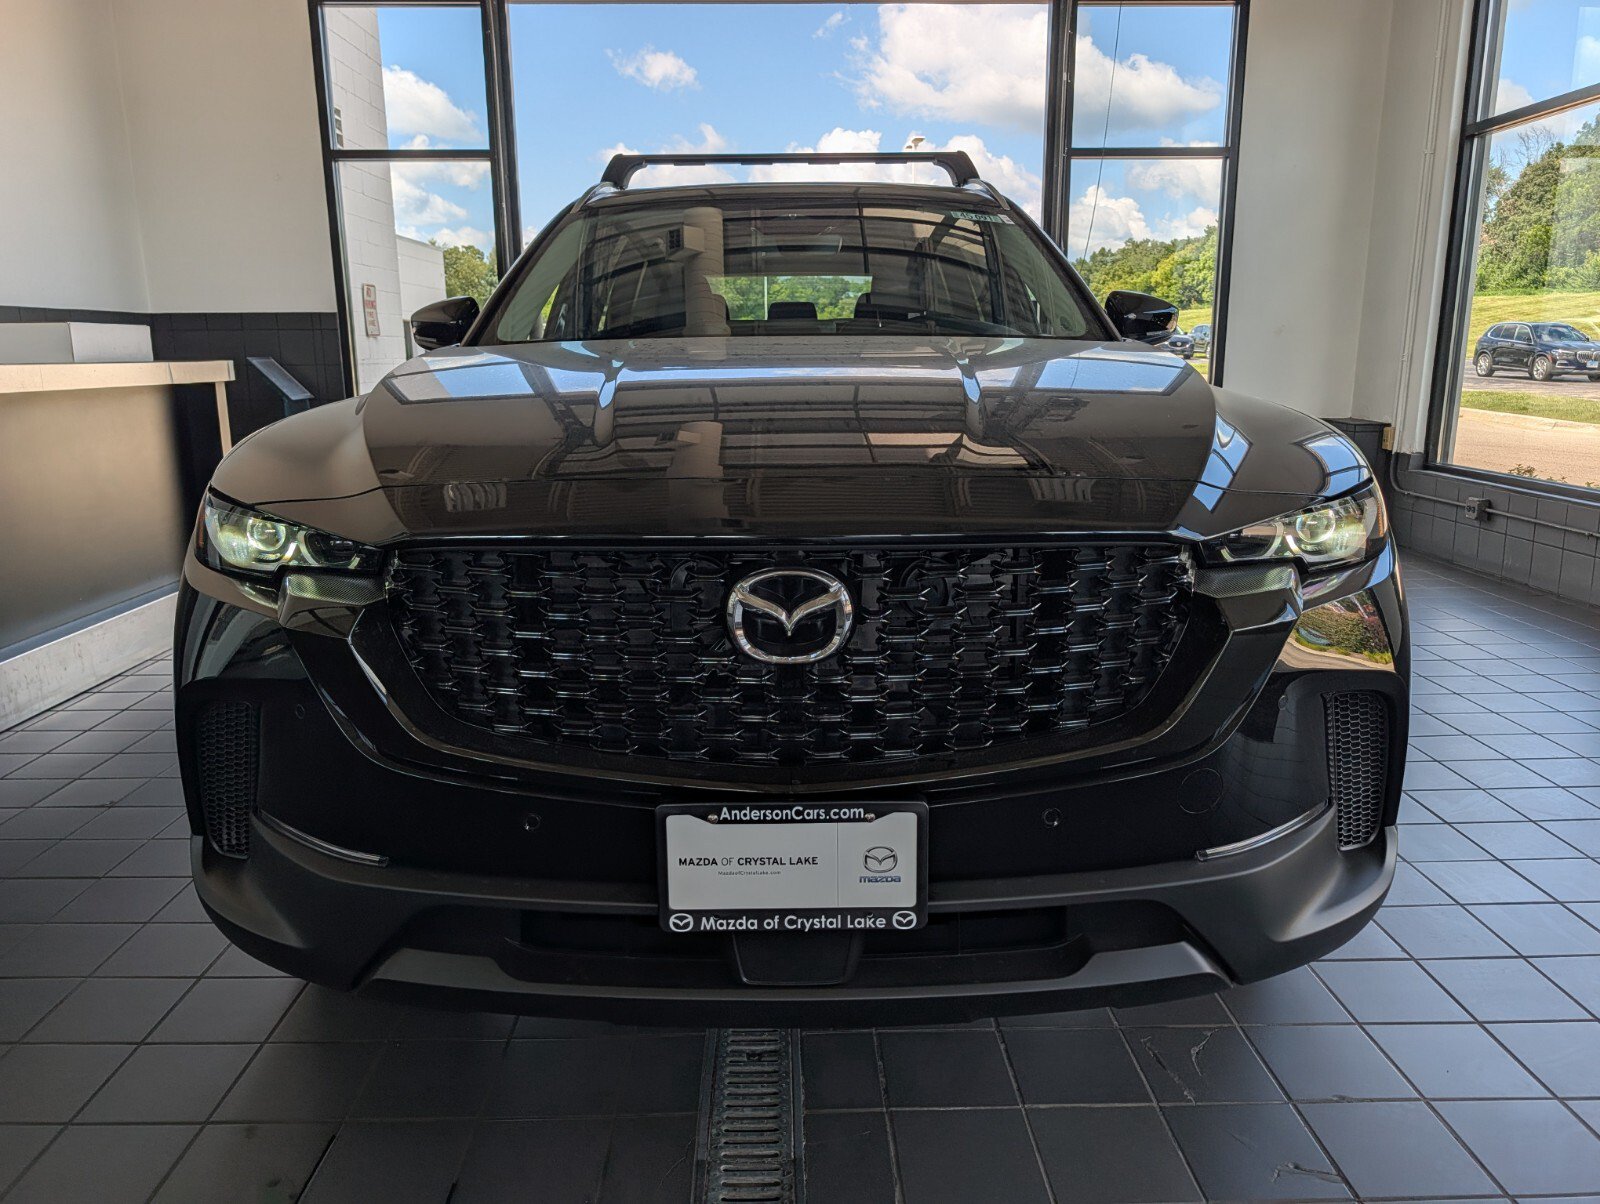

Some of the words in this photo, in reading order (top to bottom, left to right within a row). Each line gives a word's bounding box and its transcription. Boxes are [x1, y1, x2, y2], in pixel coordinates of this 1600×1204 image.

[720, 805, 864, 821] AndersonCars.com
[678, 857, 718, 866] MAZDA
[721, 857, 735, 866] OF
[737, 857, 786, 866] CRYSTAL
[789, 856, 819, 866] LAKE
[701, 916, 758, 930] Mazda
[763, 915, 779, 930] of
[784, 915, 841, 932] Crystal
[847, 914, 886, 929] Lake
